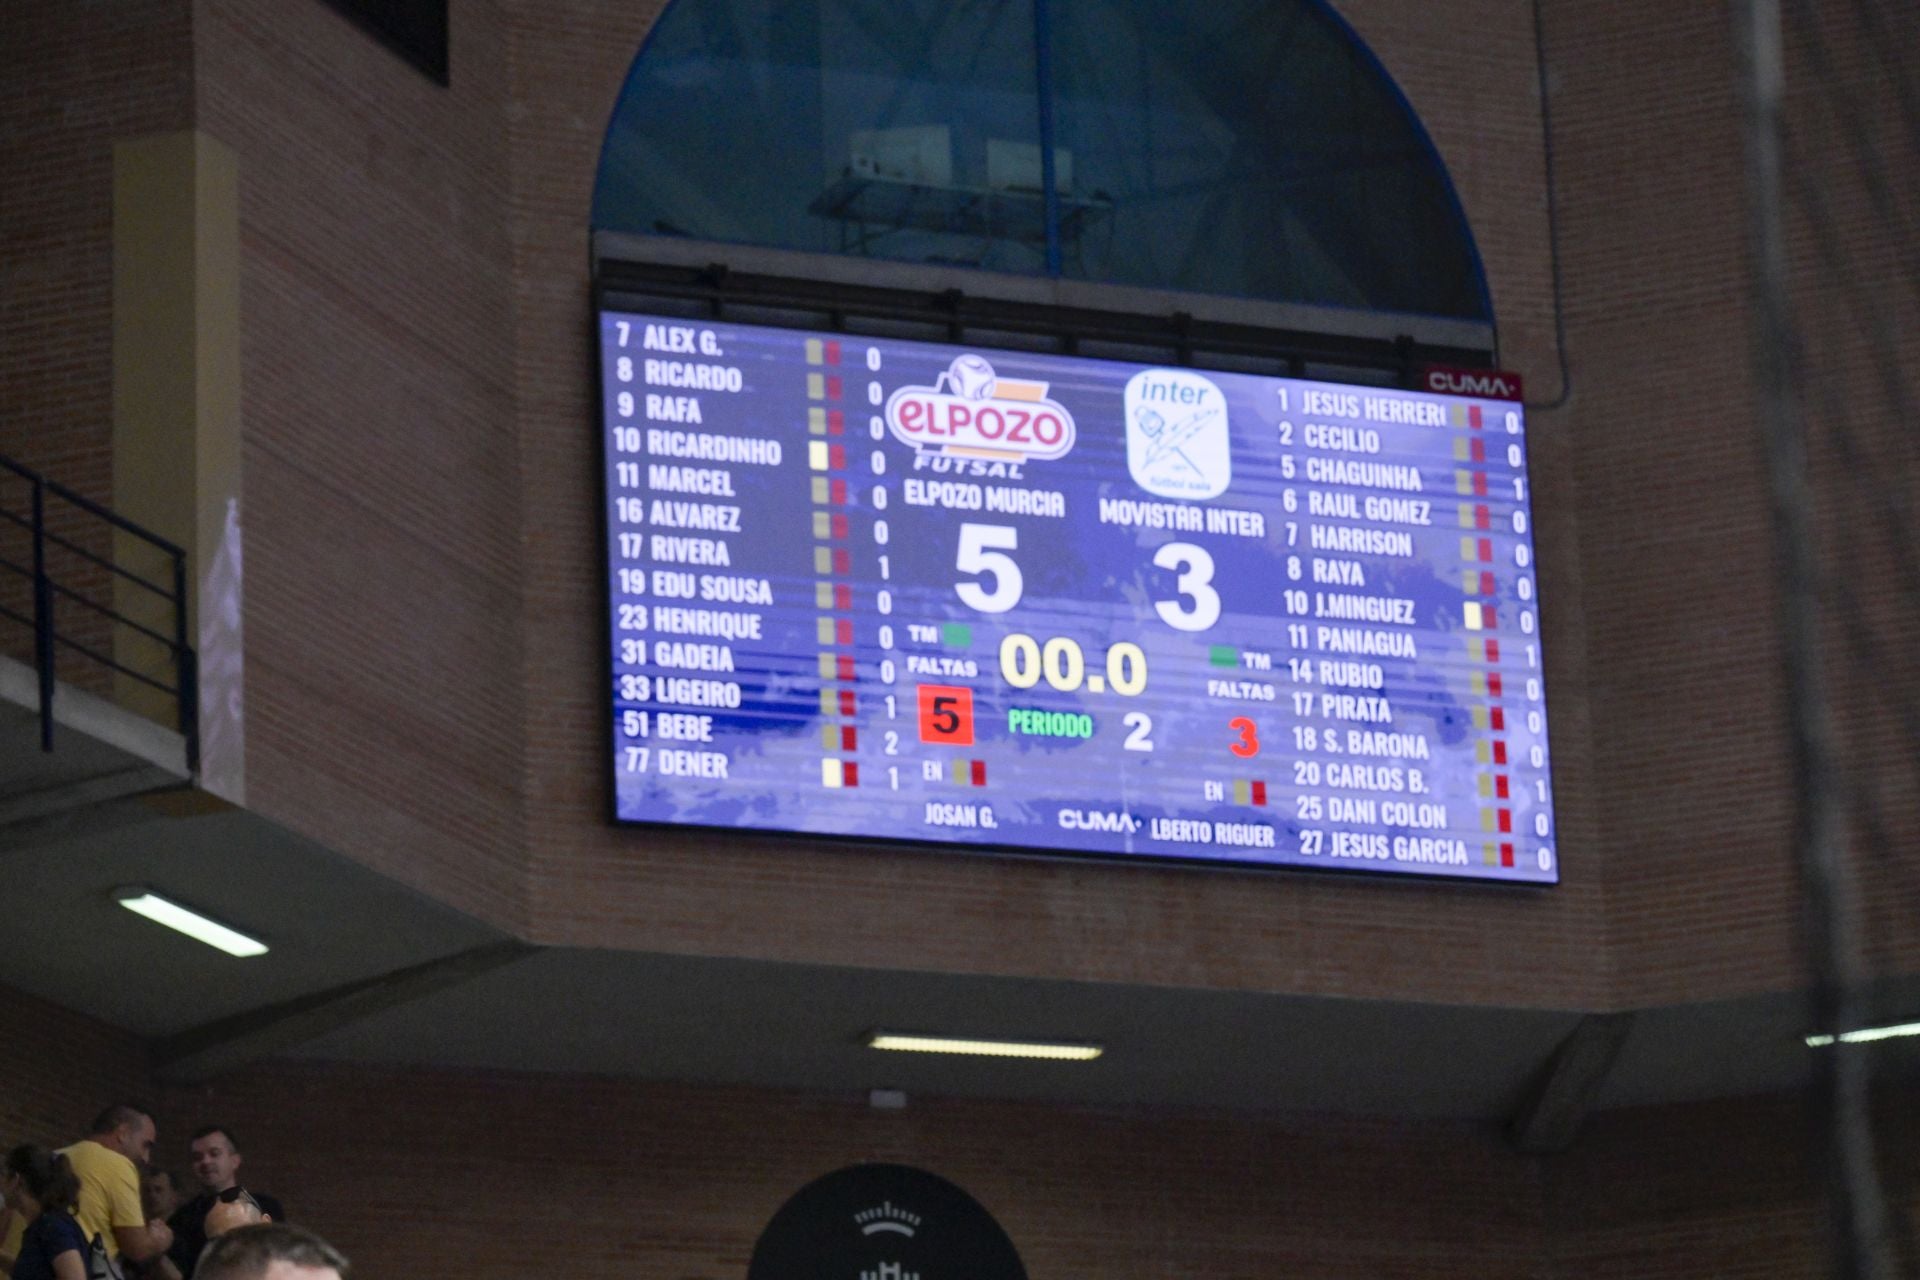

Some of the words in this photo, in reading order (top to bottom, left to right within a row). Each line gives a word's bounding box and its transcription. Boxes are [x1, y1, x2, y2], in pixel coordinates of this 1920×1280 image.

[616, 322, 630, 347] 7
[644, 324, 696, 354] ALEX
[700, 330, 723, 356] G.
[866, 347, 881, 371] 0
[617, 357, 633, 382] 8
[645, 359, 742, 392] RICARDO
[868, 381, 883, 405] 0
[1142, 376, 1208, 404] inter
[1429, 372, 1510, 396] CUMA
[617, 392, 634, 417] 9
[646, 394, 702, 424] RAFA
[870, 416, 884, 440] 0
[1277, 388, 1288, 411] 1
[1302, 390, 1359, 418] JESUS
[1505, 411, 1518, 434] 0
[613, 426, 641, 453] 10
[647, 429, 782, 466] RICARDINHO
[871, 451, 886, 475] 0
[1279, 421, 1293, 445] 2
[1304, 424, 1380, 453] CECILIO
[1508, 444, 1521, 467] 0
[616, 462, 639, 488] 11
[649, 464, 736, 496] MARCEL
[873, 485, 887, 510] 0
[914, 455, 1024, 480] FUTSAL
[1281, 455, 1296, 479] 5
[1306, 457, 1422, 491] CHAGUINHA
[1512, 477, 1523, 501] 1
[904, 478, 982, 510] ELPOZO
[985, 485, 1065, 517] MURCIA
[1100, 498, 1203, 532] MOVISTAR
[1206, 509, 1264, 537] INTER
[1283, 488, 1297, 513] 6
[1309, 490, 1361, 520] RAUL
[1365, 496, 1432, 526] GOMEZ
[1512, 510, 1526, 534] 0
[616, 497, 643, 523] 16
[650, 500, 741, 532] ALVAREZ
[874, 520, 889, 544] 0
[618, 532, 643, 558] 17
[651, 535, 730, 566] RIVERA
[878, 555, 890, 580] 1
[1285, 522, 1298, 546] 7
[1310, 524, 1413, 557] HARRISON
[1515, 543, 1529, 567] 0
[954, 522, 1023, 613] 5
[1153, 542, 1221, 631] 3
[1287, 556, 1302, 580] 8
[1312, 558, 1365, 587] RAYA
[1517, 576, 1531, 601] 0
[618, 568, 645, 594] 19
[652, 570, 695, 599] EDU
[700, 576, 773, 605] SOUSA
[877, 590, 892, 614] 0
[1283, 589, 1308, 615] 10
[1520, 610, 1533, 634] 0
[618, 604, 648, 630] 23
[653, 606, 762, 641] HENRIQUE
[879, 625, 893, 649] 0
[908, 624, 937, 644] TM
[1287, 624, 1308, 649] 11
[1317, 626, 1417, 659] PANIAGUA
[1525, 644, 1536, 668] 1
[620, 639, 646, 665] 31
[654, 641, 735, 672] GADEIA
[880, 660, 895, 684] 0
[907, 656, 978, 677] FALTAS
[1000, 633, 1148, 697] 00.0
[1243, 652, 1271, 670] TM
[1288, 658, 1312, 684] 14
[1319, 660, 1383, 689] RUBIO
[1526, 678, 1539, 701] 0
[620, 674, 650, 701] 33
[655, 677, 741, 708] LIGEIRO
[884, 695, 896, 720] 1
[1208, 680, 1275, 701] FALTAS
[1292, 691, 1313, 716] 17
[1322, 694, 1392, 723] PIRATA
[1528, 711, 1541, 734] 0
[623, 710, 649, 737] 51
[657, 713, 713, 742] BEBE
[884, 731, 898, 755] 2
[932, 697, 960, 734] 5
[1008, 709, 1093, 738] PERIODO
[1123, 711, 1154, 752] 2
[1228, 716, 1260, 758] 3
[624, 747, 649, 772] 77
[658, 749, 728, 778] DENER
[888, 766, 898, 790] 1
[1292, 726, 1317, 751] 18
[1323, 728, 1343, 753] S.
[1347, 730, 1429, 760] BARONA
[1530, 745, 1543, 768] 0
[923, 760, 942, 782] EN
[1205, 781, 1223, 802] EN
[1294, 760, 1320, 786] 20
[1326, 763, 1404, 792] CARLOS
[1408, 769, 1429, 794] B.
[1535, 779, 1546, 803] 1
[925, 803, 976, 827] JOSAN
[979, 807, 998, 829] G.
[1297, 795, 1322, 820] 25
[1329, 797, 1376, 824] DANI
[1381, 801, 1447, 829] COLON
[1535, 813, 1549, 837] 0
[1299, 830, 1323, 855] 27
[1331, 831, 1389, 859] JESUS
[1393, 836, 1469, 865] GARCIA
[1538, 847, 1551, 871] 0
